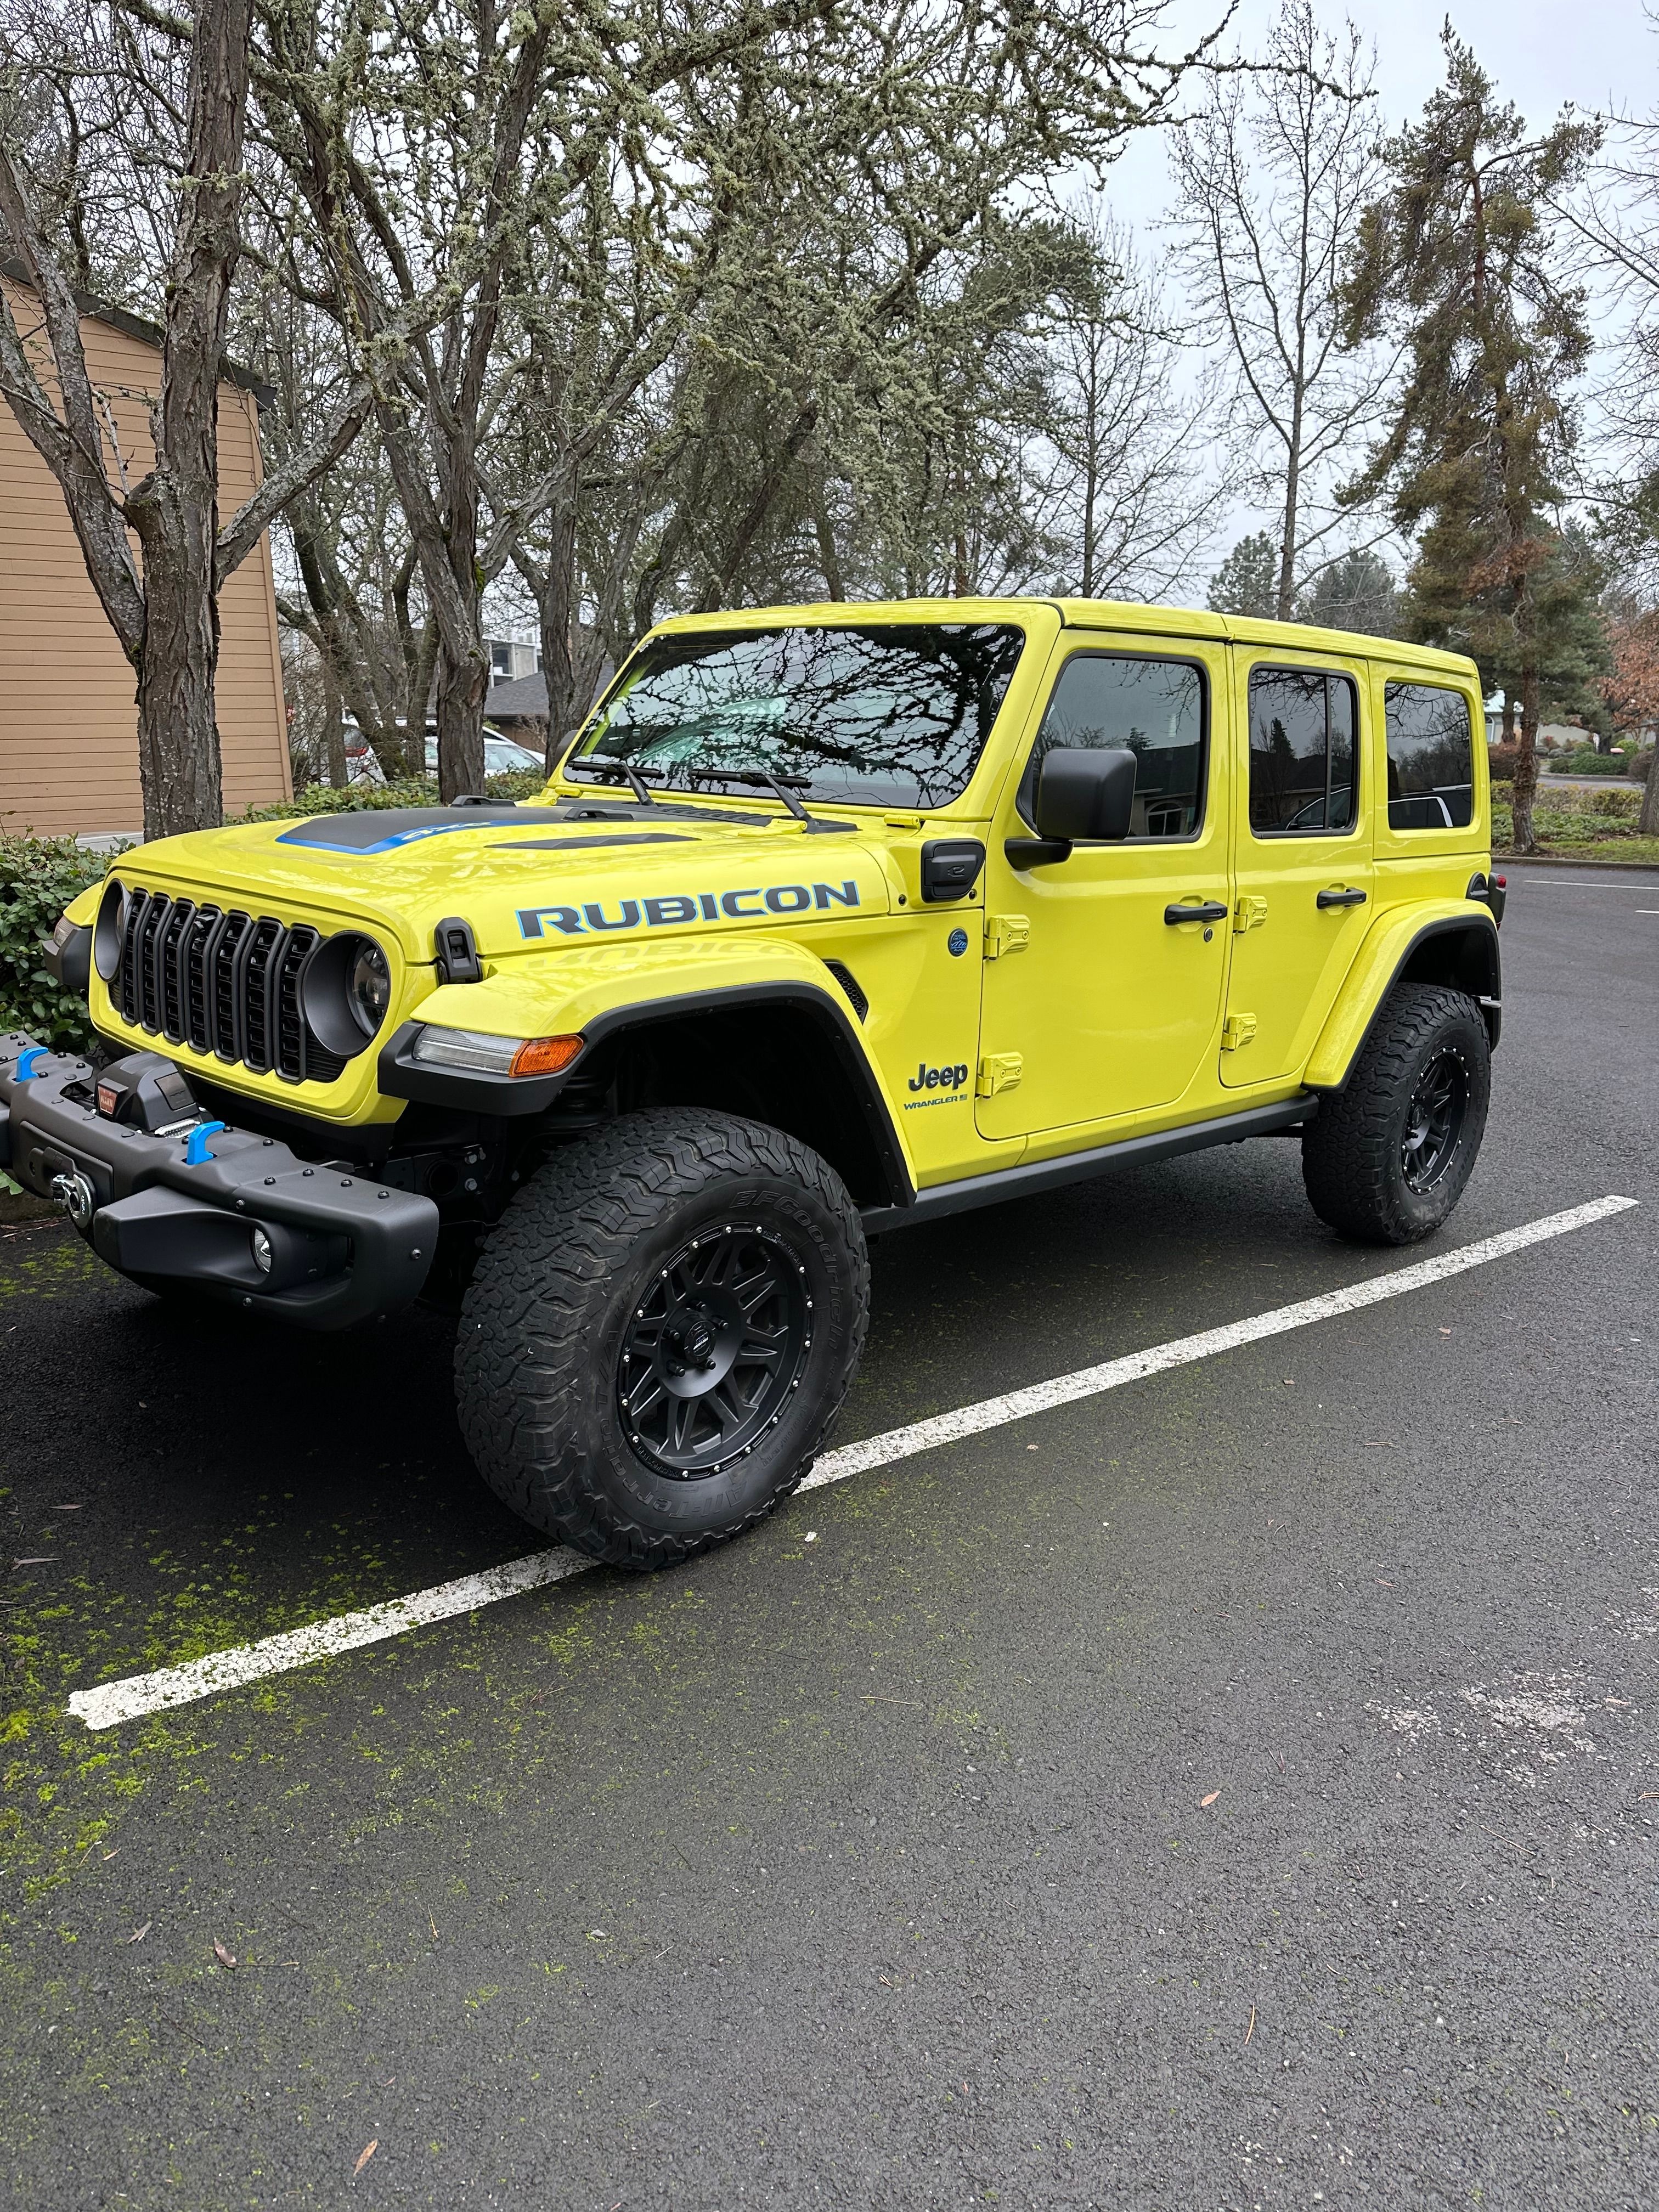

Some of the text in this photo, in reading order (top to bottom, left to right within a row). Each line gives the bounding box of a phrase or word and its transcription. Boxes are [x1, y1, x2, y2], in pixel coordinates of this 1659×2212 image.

[515, 881, 861, 939] RUBICON
[904, 1096, 958, 1110] WRANGLER
[908, 1062, 968, 1092] Jeep
[729, 1189, 843, 1350] BFGoodrich
[600, 1418, 747, 1519] All-Terrain
